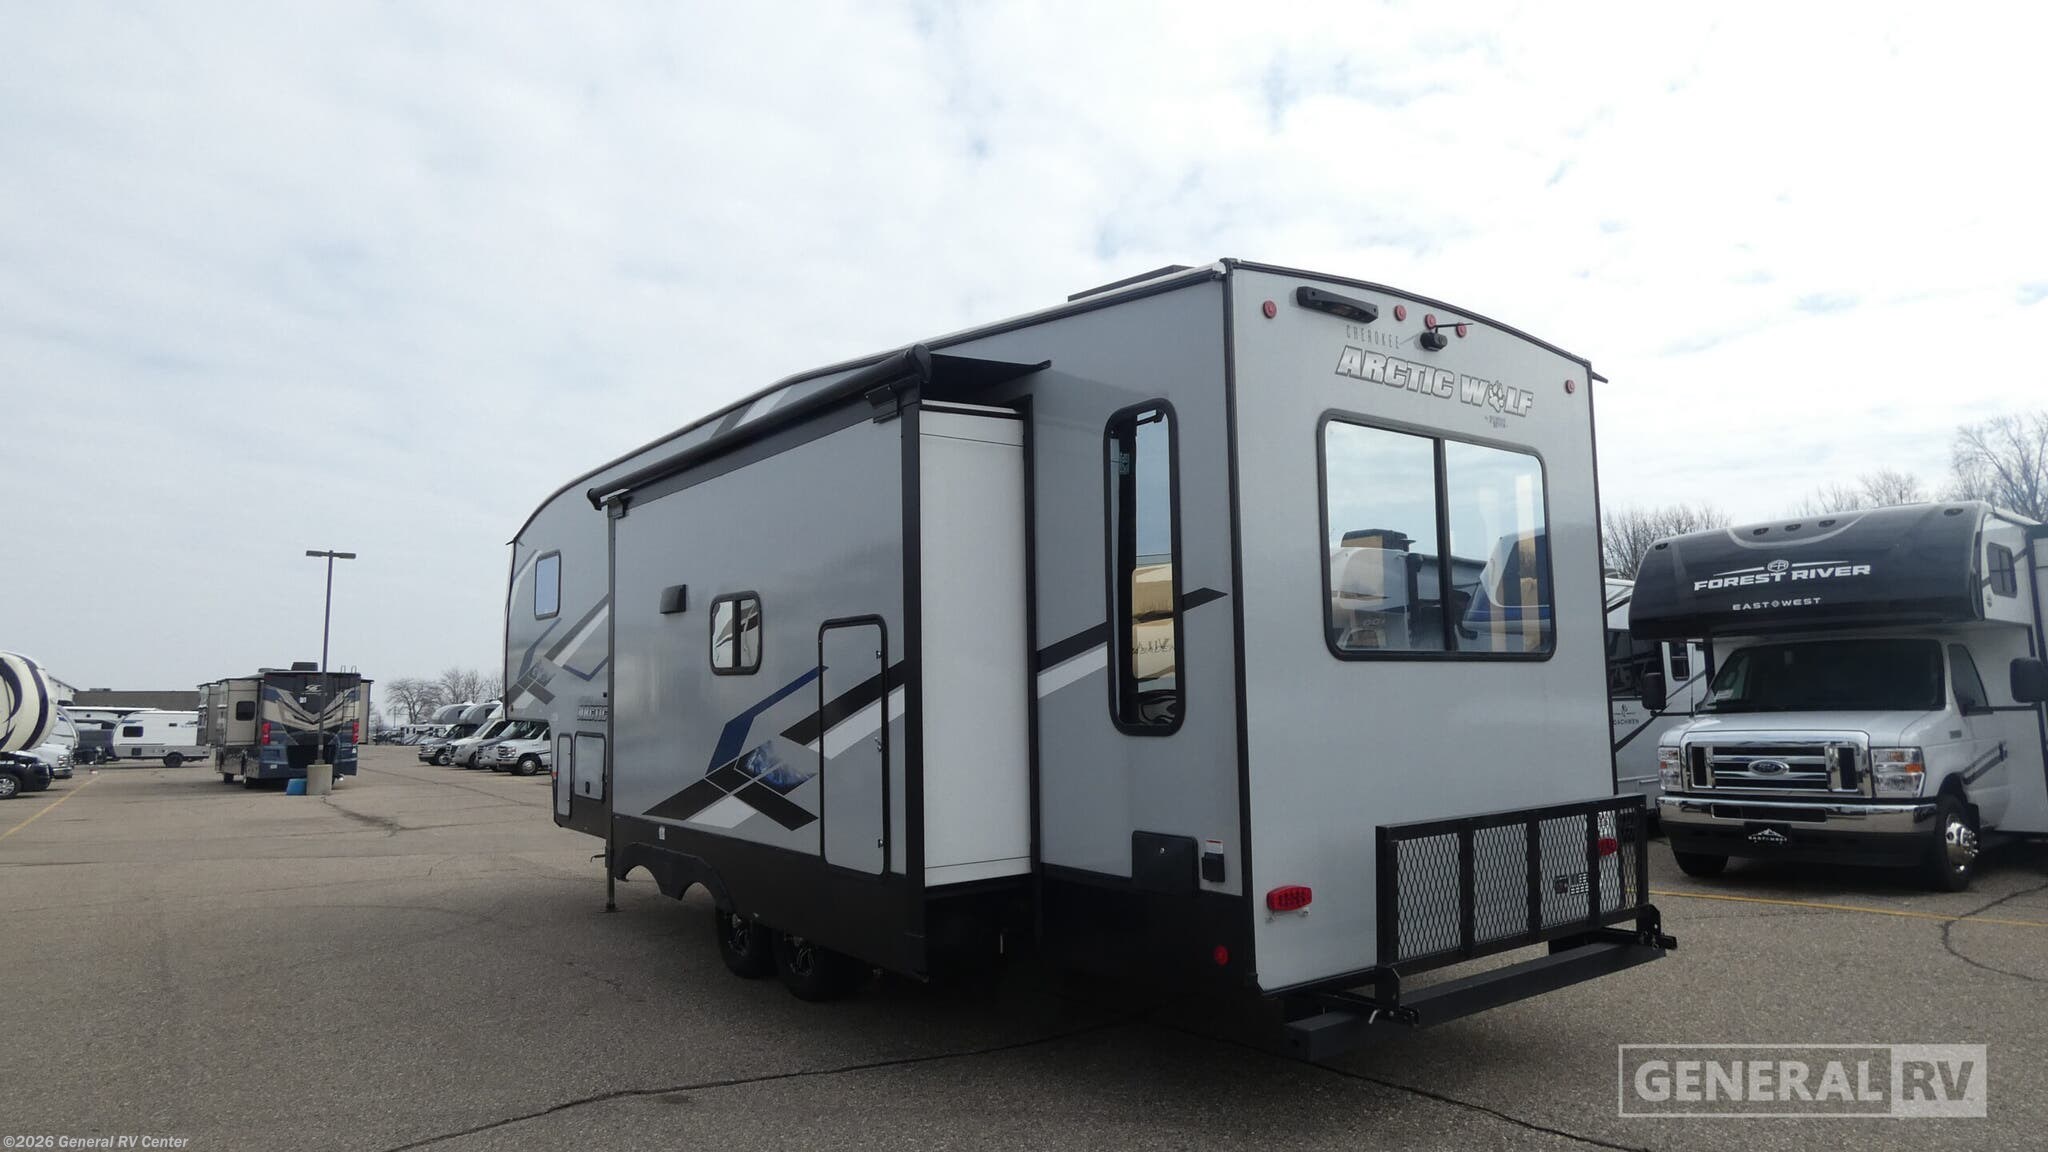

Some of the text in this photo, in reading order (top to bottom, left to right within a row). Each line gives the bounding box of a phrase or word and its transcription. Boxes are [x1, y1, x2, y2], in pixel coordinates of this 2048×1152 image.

[1346, 325, 1400, 349] CHEROKEE
[1335, 345, 1455, 400] ARCTIC
[1694, 565, 1871, 591] FOREST RIVER
[1732, 597, 1822, 611] EAST WEST
